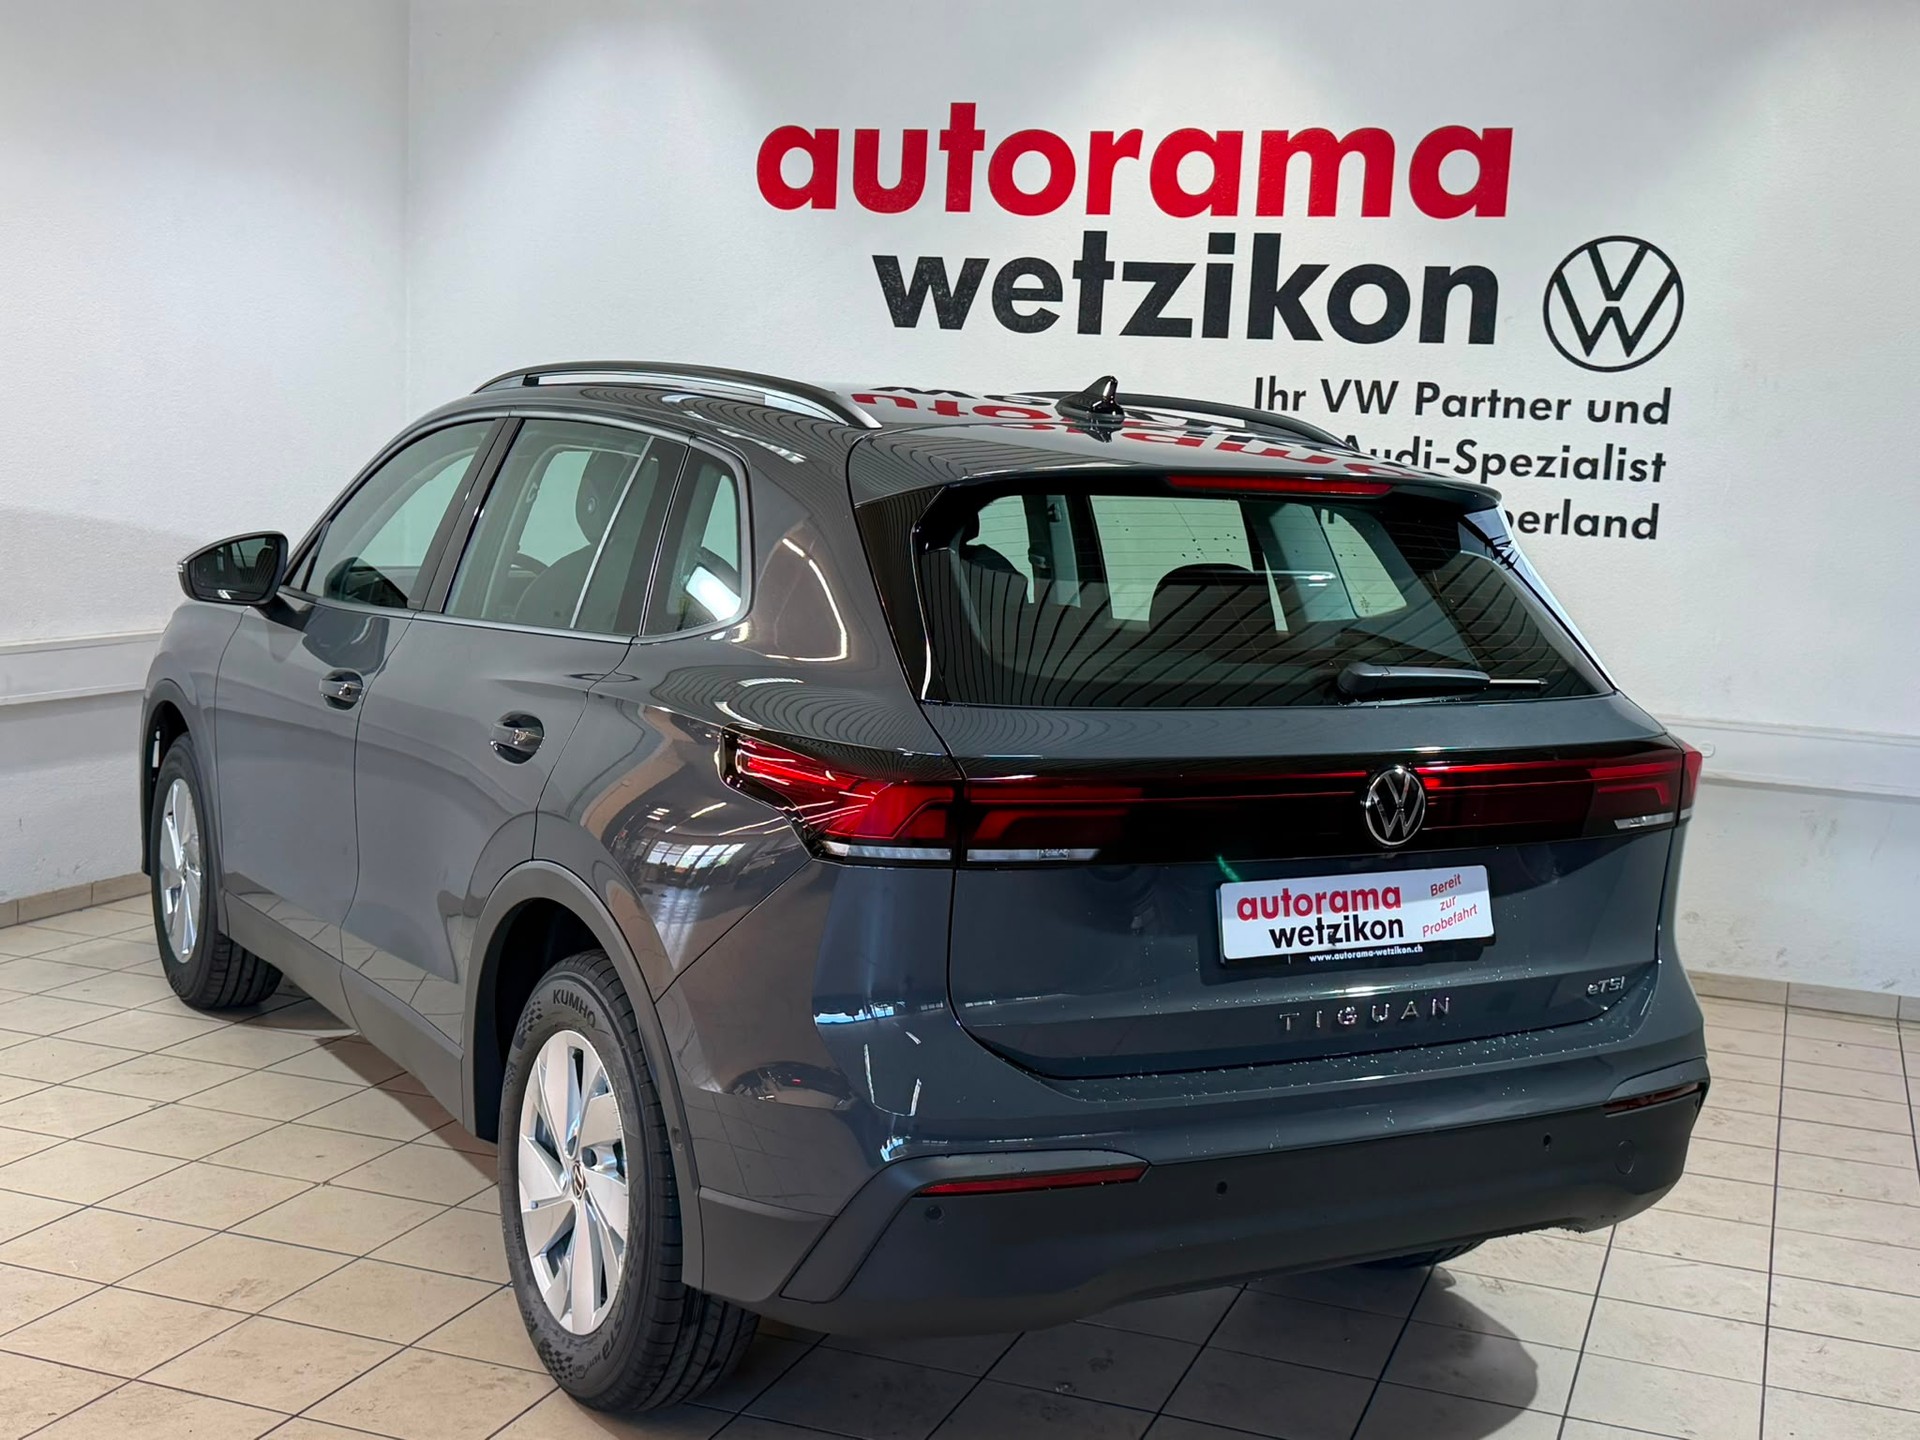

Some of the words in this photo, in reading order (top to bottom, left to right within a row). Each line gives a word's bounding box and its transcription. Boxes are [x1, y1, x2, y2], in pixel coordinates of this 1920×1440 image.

[757, 103, 1513, 219] autorama
[872, 231, 1499, 345] wetzikon
[1254, 376, 1307, 412] Ihr
[1321, 379, 1399, 415] VW
[1416, 381, 1572, 421] Partner
[1587, 387, 1672, 425] und
[1504, 499, 1660, 540] erland
[1430, 873, 1462, 897] Bereit
[1237, 886, 1402, 922] autorama
[1421, 903, 1478, 938] Probefahrt
[1439, 896, 1457, 912] zur
[1269, 914, 1404, 949] wetzikon
[1309, 944, 1424, 963] www.autorama-wetzikon.ch
[553, 988, 596, 1029] KUMHO
[1279, 997, 1450, 1031] TIGUAN
